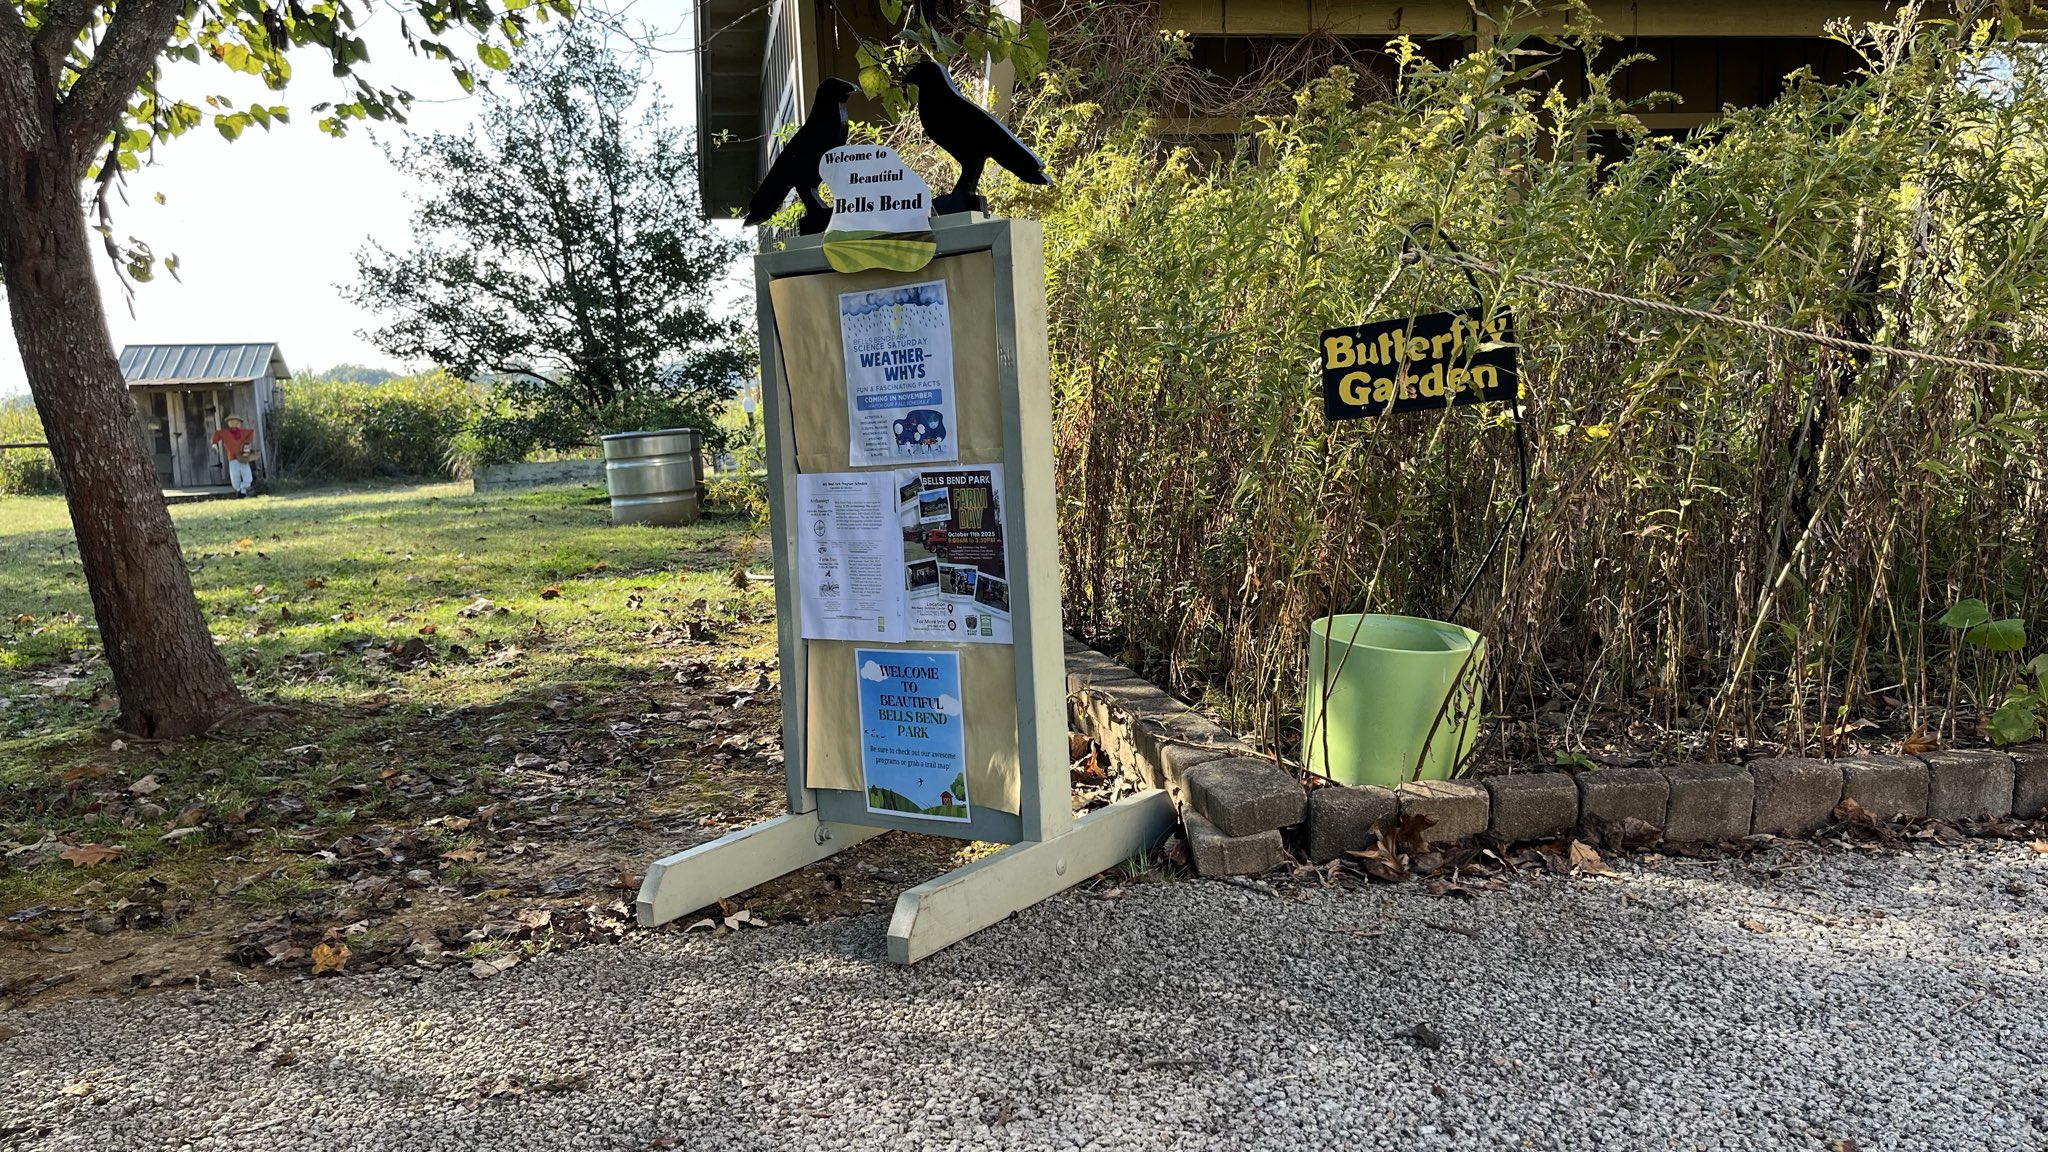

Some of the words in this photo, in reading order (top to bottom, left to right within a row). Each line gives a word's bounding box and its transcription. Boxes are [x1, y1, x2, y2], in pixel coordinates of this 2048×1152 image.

[825, 150, 872, 165] Welcome
[875, 149, 887, 160] to
[850, 169, 904, 185] Beautiful
[835, 197, 874, 214] Bells
[879, 193, 922, 212] Bend
[853, 343, 884, 352] SCIENCE
[887, 338, 928, 349] SATURDAY
[884, 364, 926, 381] WHYS
[876, 383, 916, 391] FASCINATING
[1338, 363, 1498, 406] Garden
[922, 477, 944, 485] BELLS
[946, 476, 967, 485] BEND
[968, 475, 990, 484] PARK
[953, 488, 988, 509] FARM
[959, 508, 983, 529] DAY
[880, 665, 939, 679] WELCOME
[901, 682, 918, 693] TO
[880, 695, 943, 710] BEAUTIFUL
[879, 709, 913, 722] BELLS
[916, 713, 947, 724] BEND
[898, 725, 928, 738] PARK
[896, 747, 910, 756] check
[876, 757, 900, 766] programs
